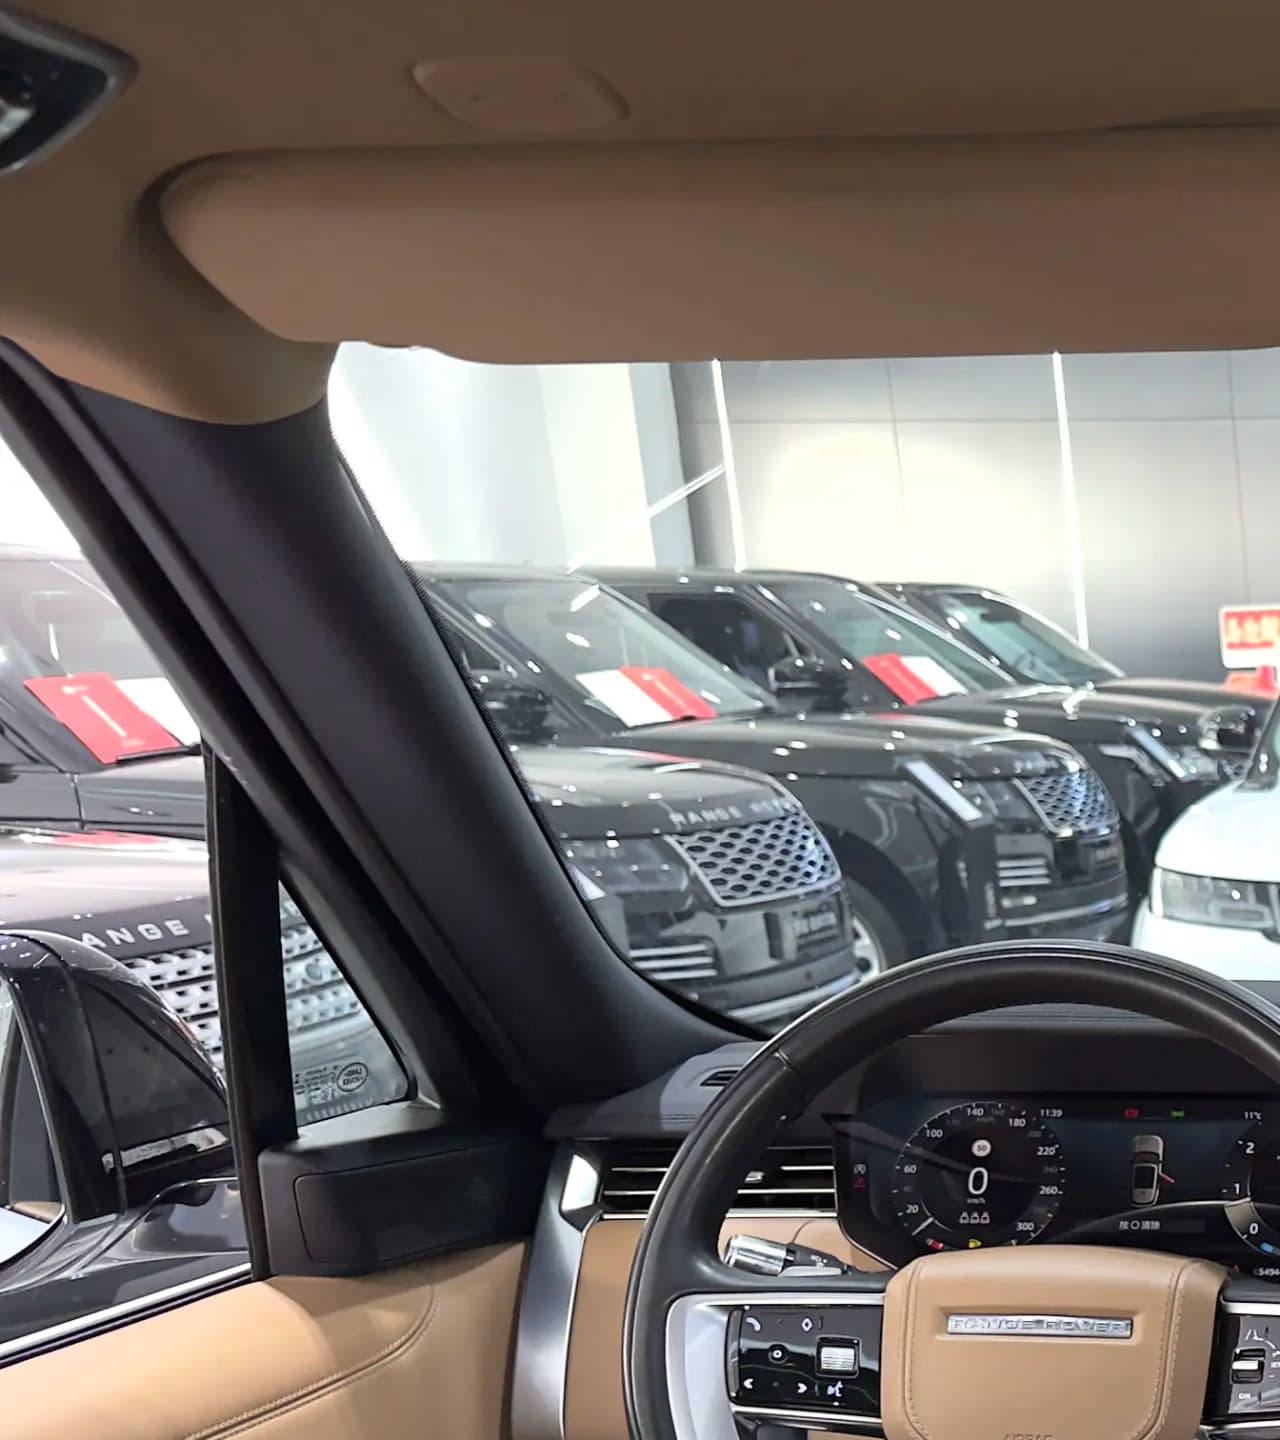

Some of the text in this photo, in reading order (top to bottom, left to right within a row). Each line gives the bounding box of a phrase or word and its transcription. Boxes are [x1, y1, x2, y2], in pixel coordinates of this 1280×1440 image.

[79, 919, 190, 950] ANGE
[966, 1108, 984, 1117] 140
[1008, 1118, 1026, 1127] 180
[925, 1129, 943, 1138] 100
[1037, 1147, 1056, 1156] 220
[1245, 1142, 1255, 1154] 2
[903, 1165, 917, 1174] 60
[967, 1167, 989, 1195] 0
[1039, 1186, 1058, 1195] 260
[1234, 1183, 1240, 1195] 1
[906, 1204, 919, 1214] 20
[1016, 1222, 1035, 1231] 300
[1249, 1223, 1259, 1235] 0
[951, 1317, 1132, 1335] RANGE ROVER
